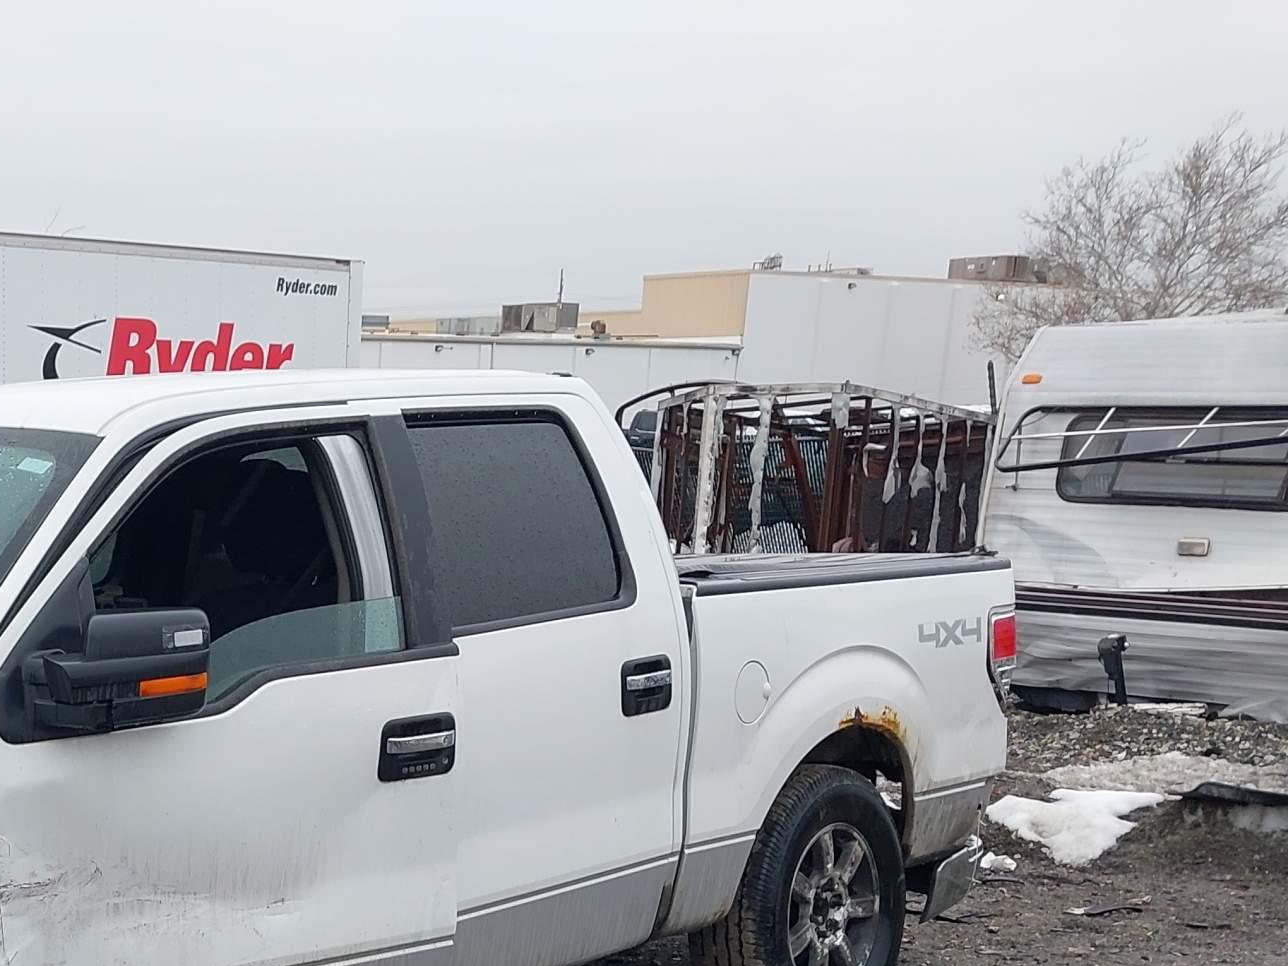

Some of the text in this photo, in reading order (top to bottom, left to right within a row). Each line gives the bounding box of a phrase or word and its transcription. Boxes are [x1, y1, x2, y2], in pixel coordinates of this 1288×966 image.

[276, 277, 338, 296] Ryder.com
[106, 317, 295, 376] Ryder
[918, 616, 982, 648] 4X4
